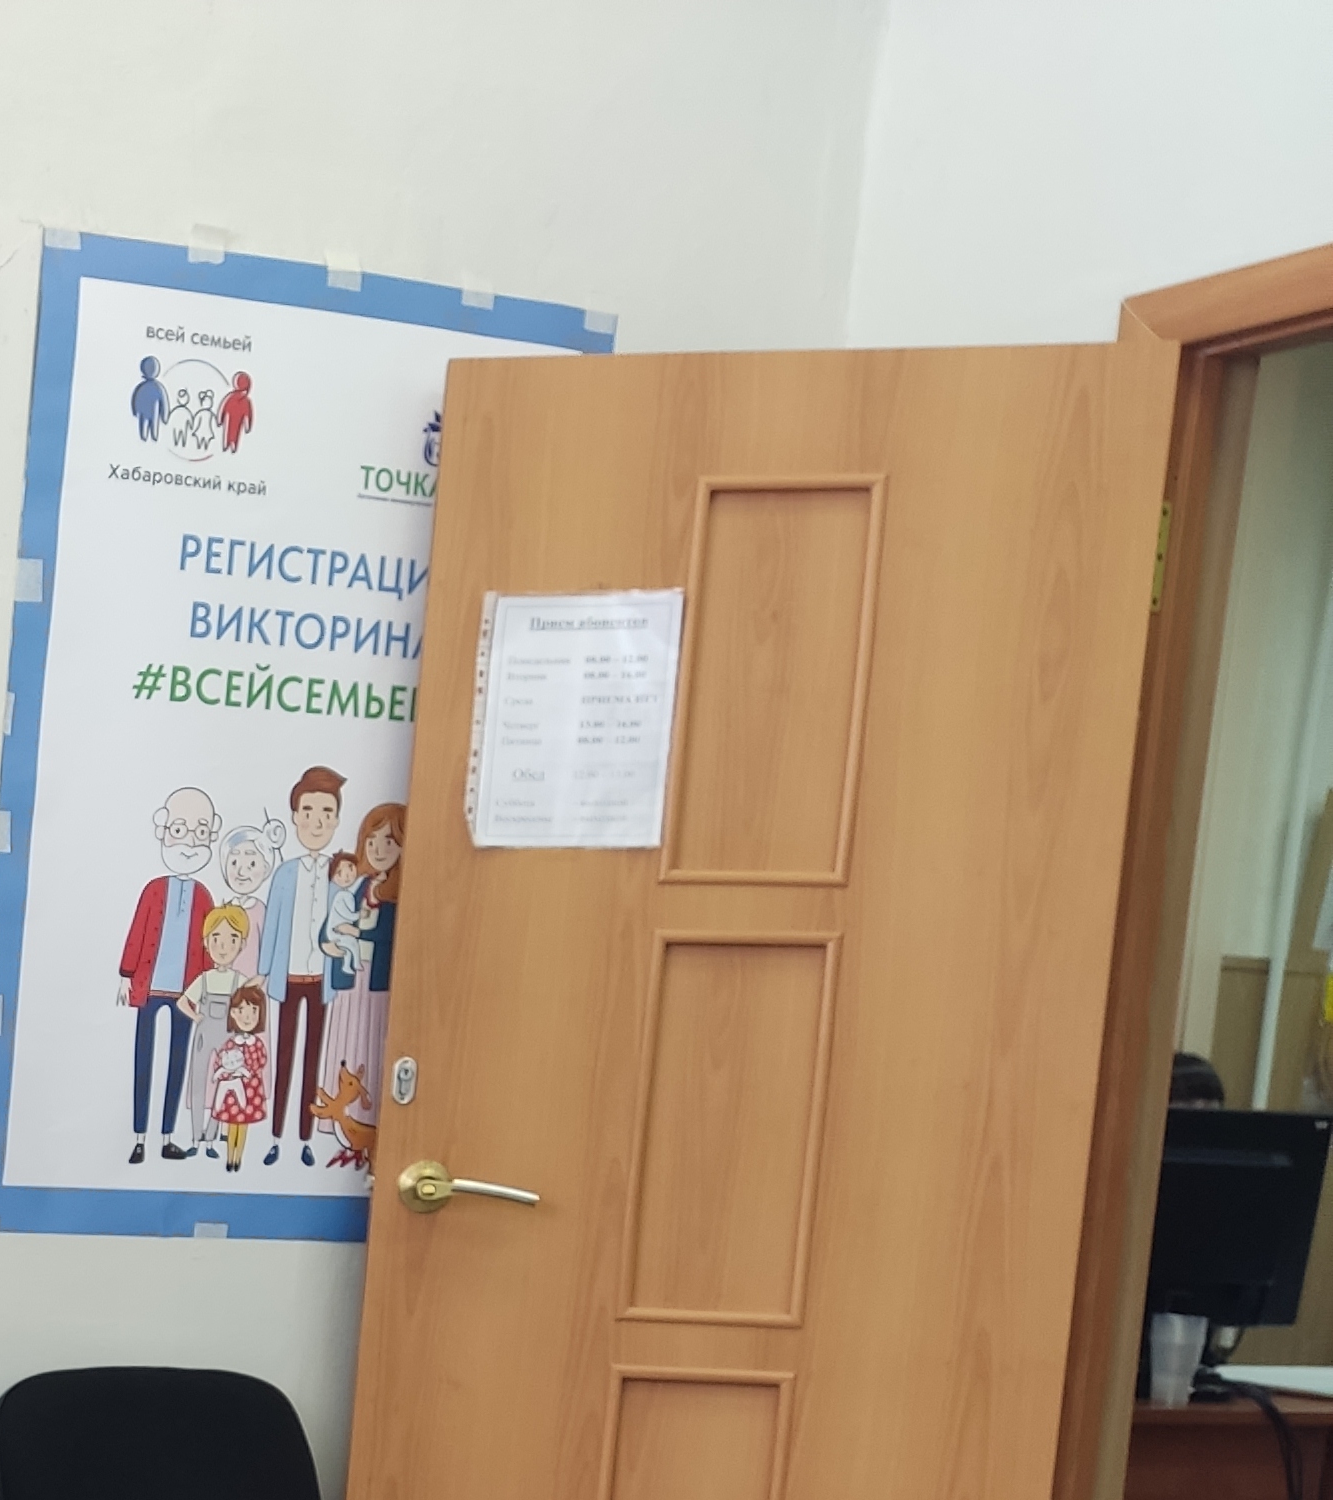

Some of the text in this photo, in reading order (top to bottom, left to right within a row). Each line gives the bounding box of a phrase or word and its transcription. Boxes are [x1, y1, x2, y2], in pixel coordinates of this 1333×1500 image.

[146, 325, 252, 352] всей семьей
[108, 463, 268, 496] Хабаровский край
[132, 662, 417, 724] #ВСЕЙСЕМЬЕ
